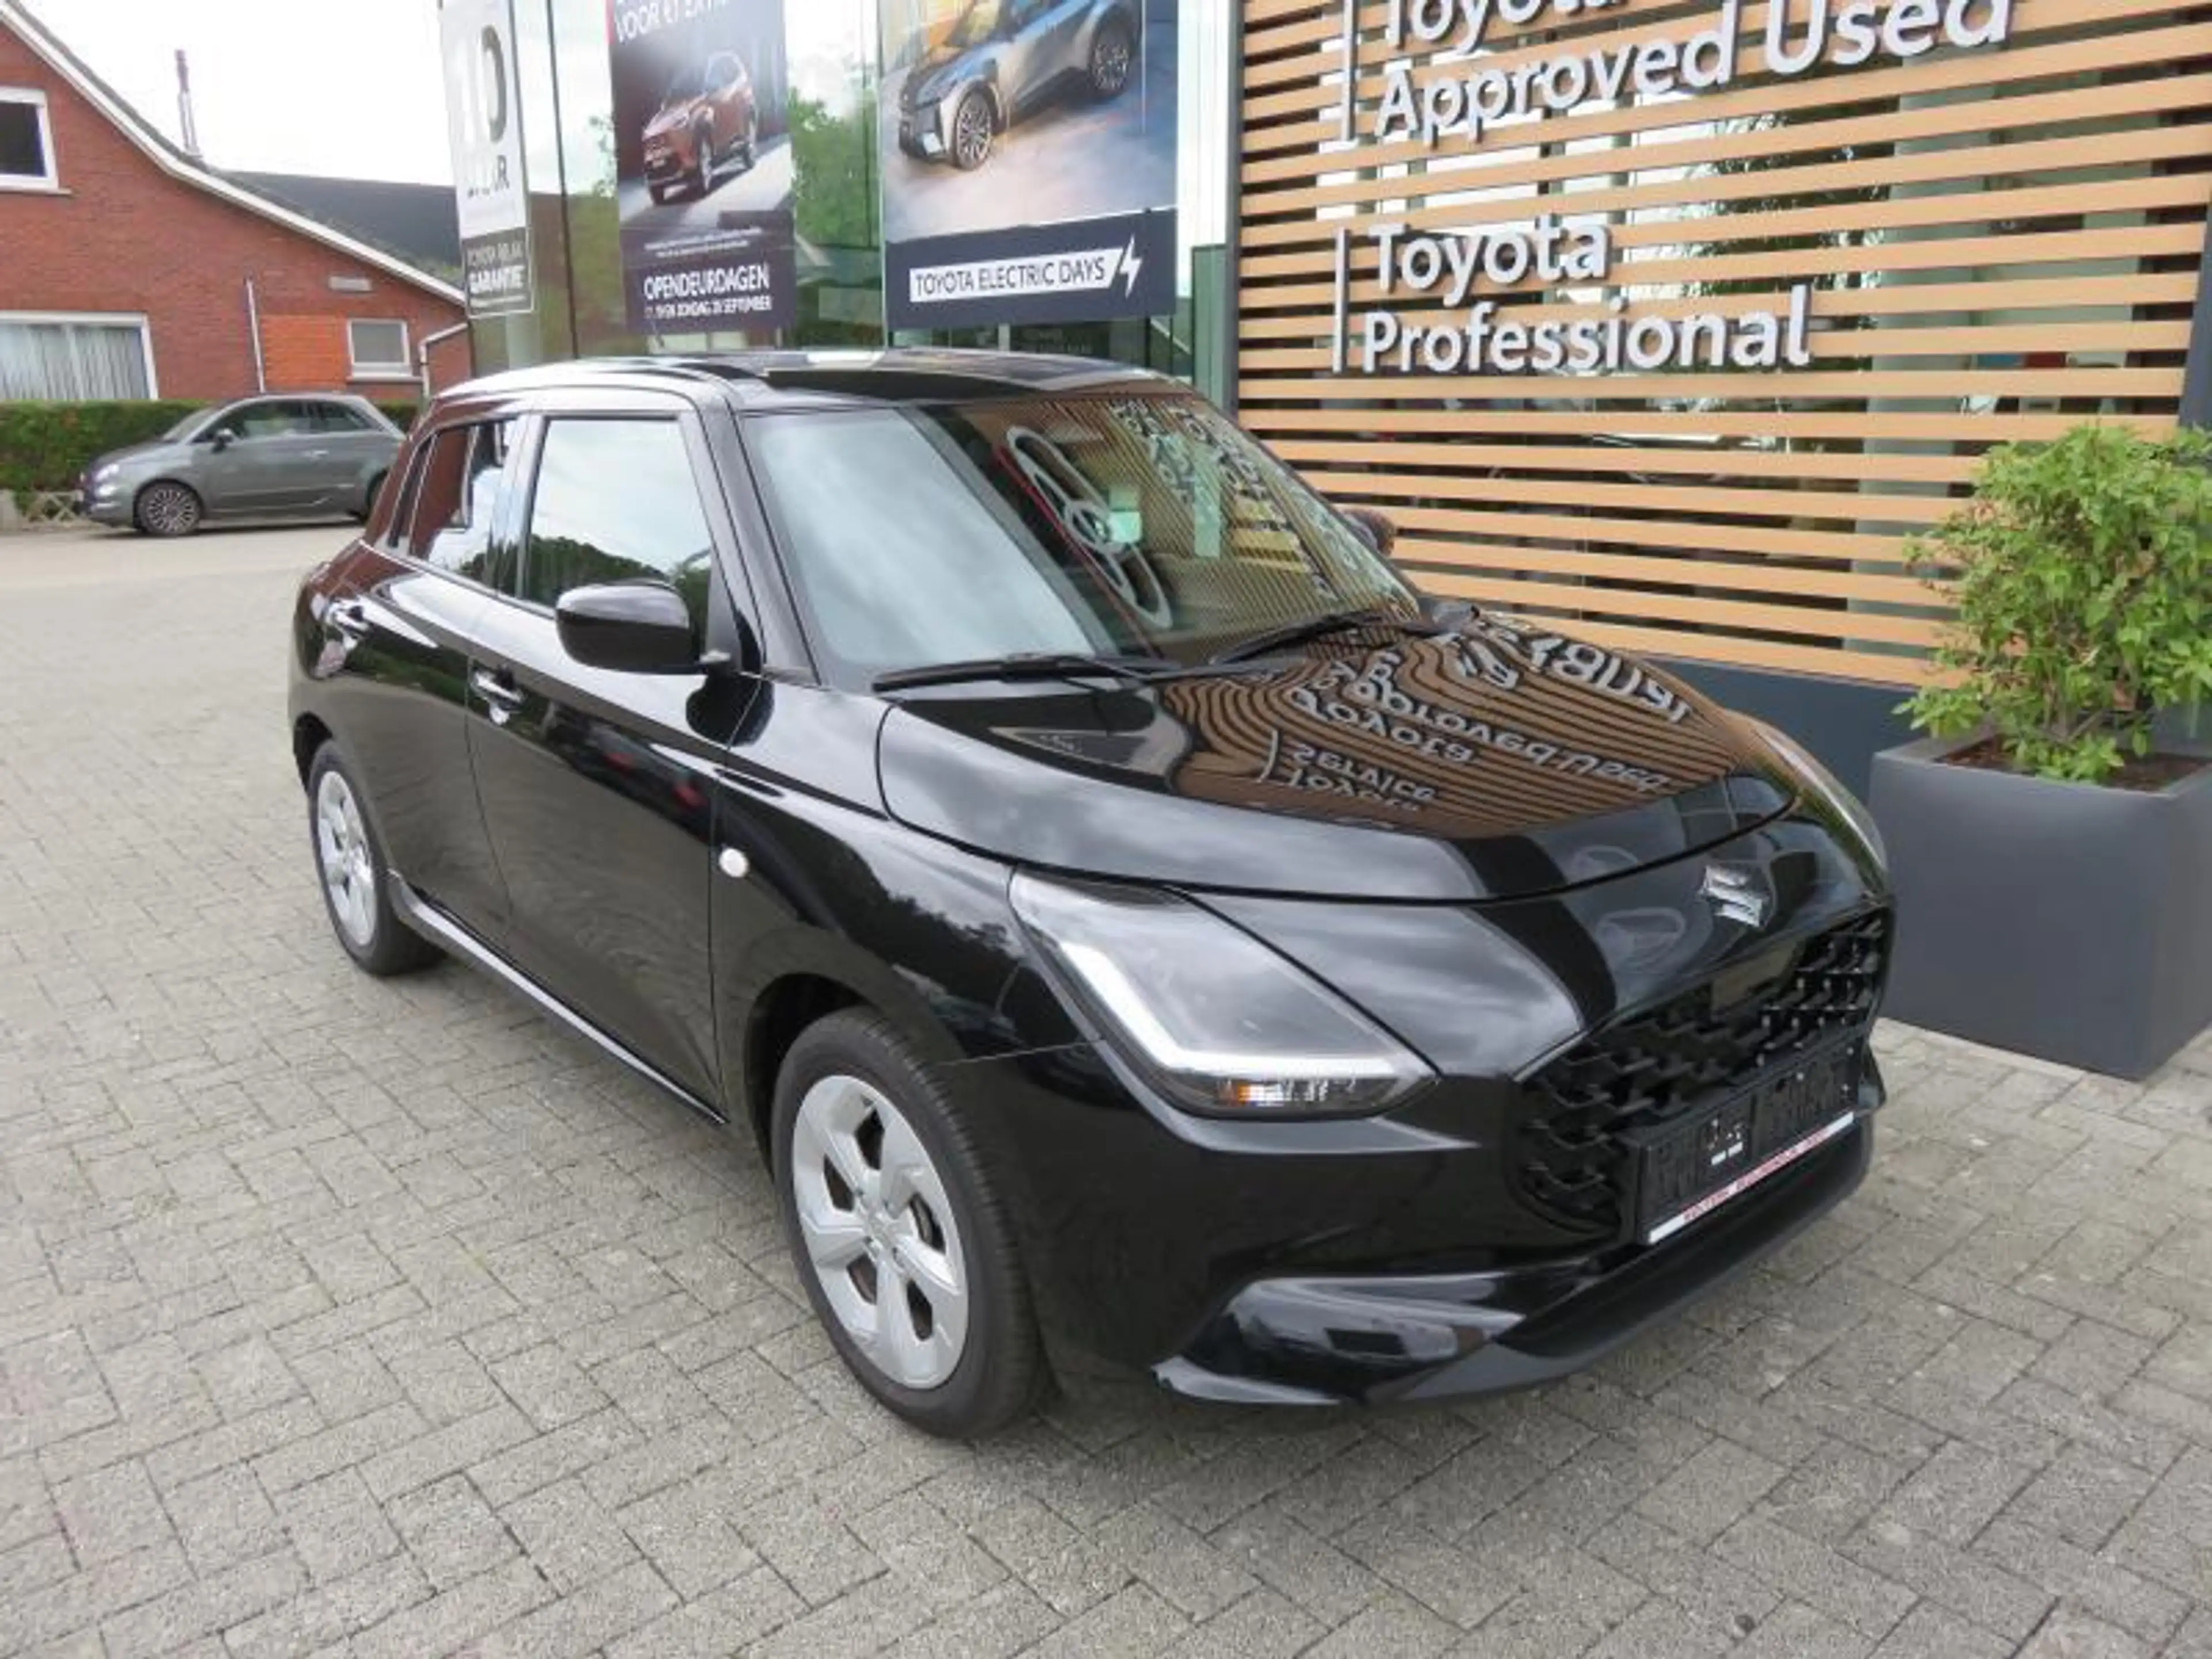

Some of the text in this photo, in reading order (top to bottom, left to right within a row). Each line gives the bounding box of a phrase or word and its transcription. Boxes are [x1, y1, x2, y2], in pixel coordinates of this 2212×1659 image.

[1384, 0, 1612, 54] Toy
[1375, 0, 1736, 146] Approved
[644, 261, 770, 300] OPENDEURDAGEN
[916, 256, 1105, 296] TOYOTA ELECTRIC DAYS
[1368, 214, 1608, 307] Toyota
[1362, 284, 1810, 373] Professional
